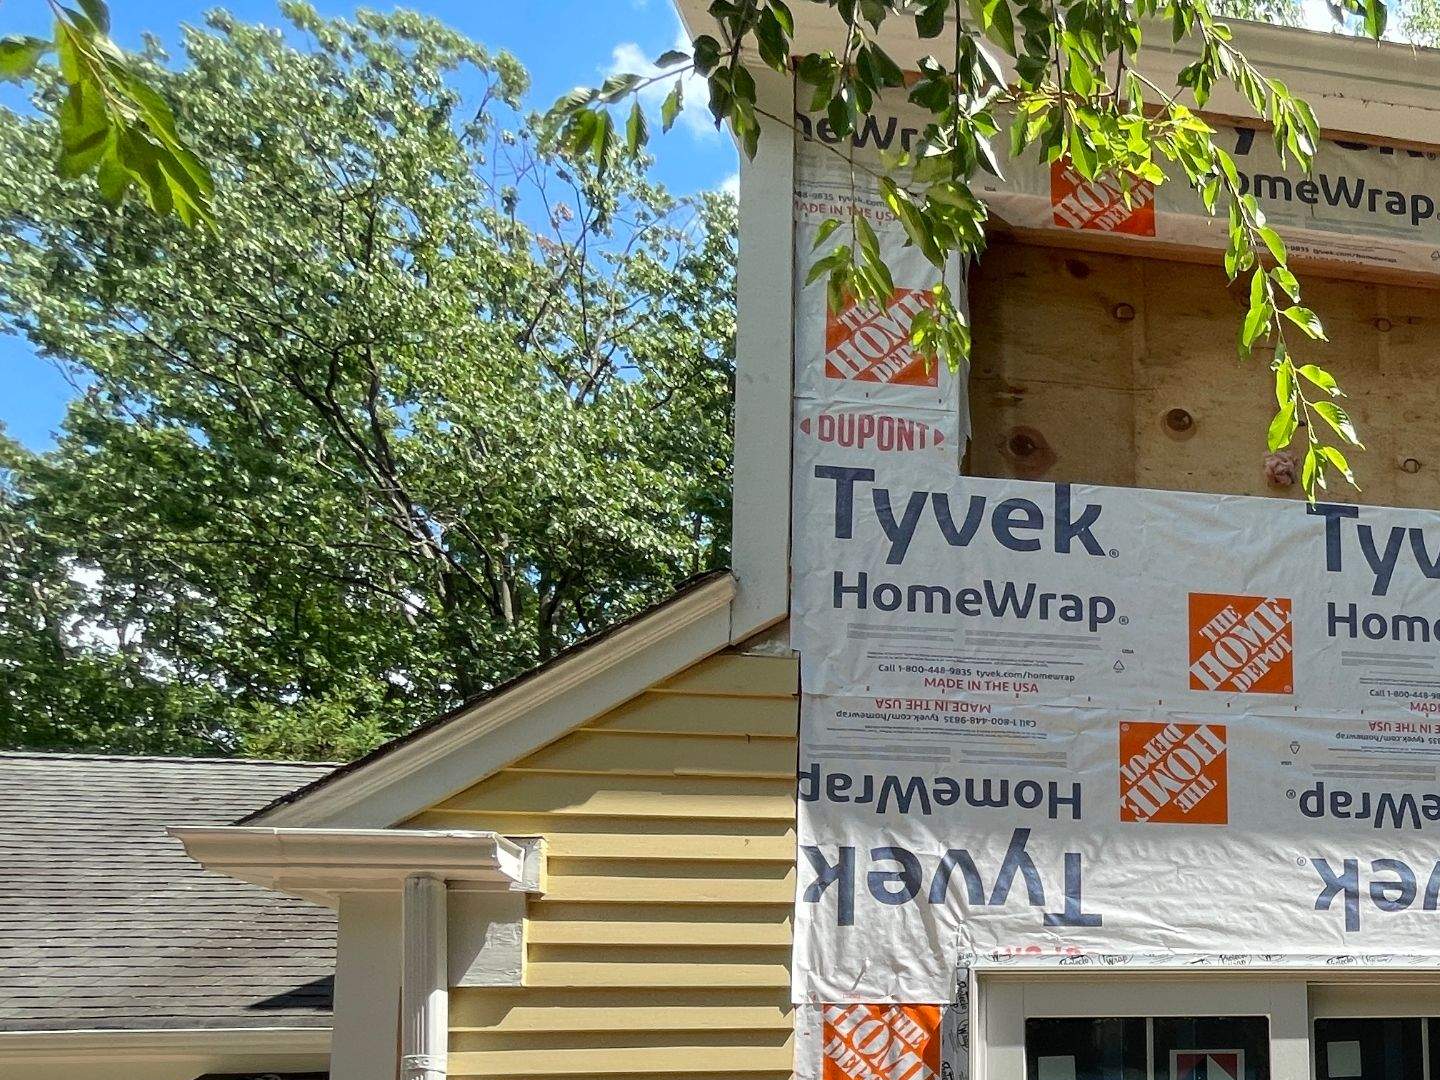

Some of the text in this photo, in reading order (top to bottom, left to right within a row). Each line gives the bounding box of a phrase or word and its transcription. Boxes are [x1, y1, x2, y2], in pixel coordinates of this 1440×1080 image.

[818, 415, 930, 451] DUPONT
[814, 465, 1105, 565] Tyvek
[832, 571, 1117, 632] HomeWrap
[1198, 604, 1244, 642] THE
[1189, 598, 1292, 692] HOME
[1236, 633, 1294, 692] DEPOT
[878, 664, 896, 673] Call
[897, 665, 973, 677] 1-800-448-9835
[924, 677, 1040, 694] MADE IN THE USA
[875, 698, 992, 713] MADE IN THE USA
[1369, 689, 1386, 698] Call
[1018, 719, 1038, 728] Call
[1368, 721, 1393, 732] USA
[1395, 722, 1418, 733] THE
[1419, 724, 1432, 734] IN
[1120, 725, 1185, 785] DEPOT
[799, 764, 1083, 820] HomeWrap
[1120, 728, 1228, 822] HOME
[1172, 779, 1218, 815] THE
[799, 828, 1103, 927] Tyvek
[881, 1005, 930, 1049] THE
